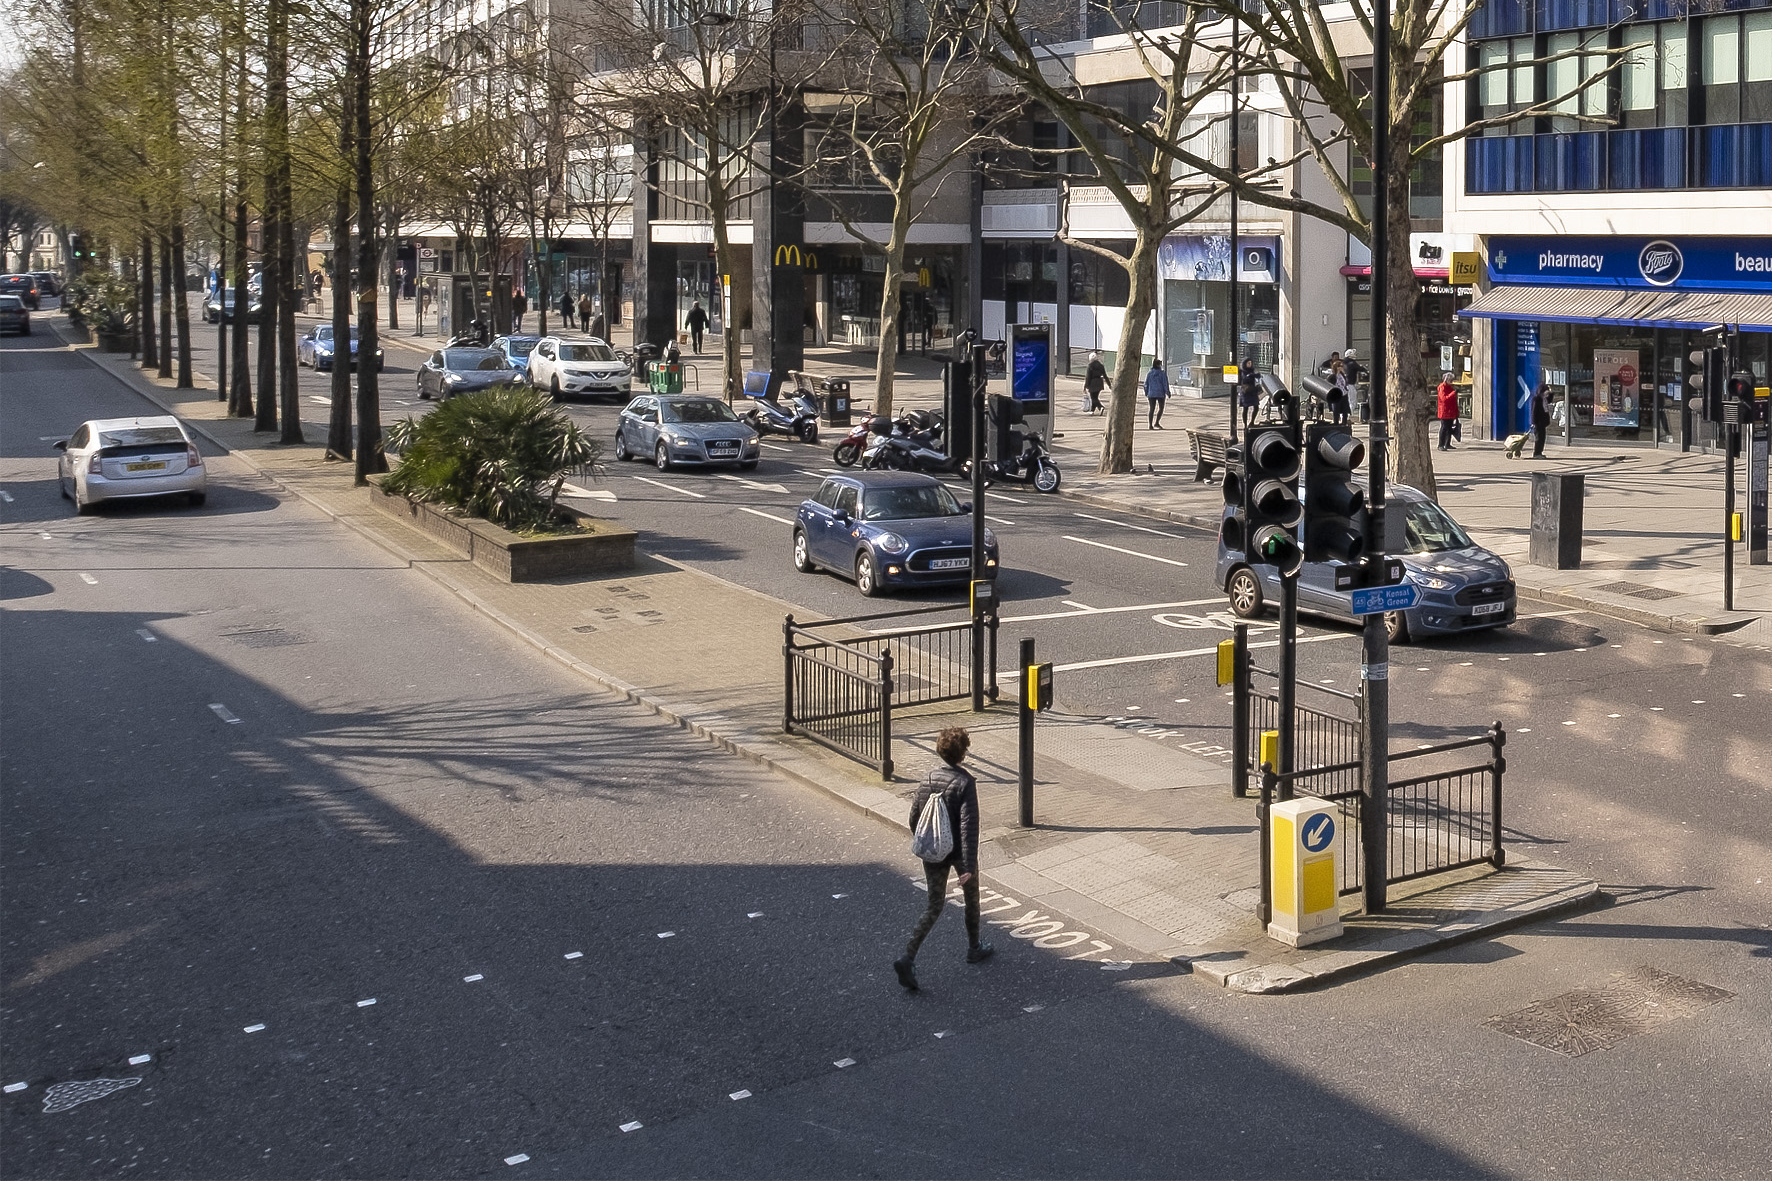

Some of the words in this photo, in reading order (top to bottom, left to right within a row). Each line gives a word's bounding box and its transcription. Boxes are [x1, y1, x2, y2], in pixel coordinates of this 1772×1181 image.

[1456, 261, 1477, 274] itsu
[1539, 250, 1604, 272] pharmacy
[1643, 249, 1674, 275] Boots
[1385, 588, 1410, 598] Kensal
[1386, 598, 1409, 607] Green
[1114, 719, 1185, 739] LOOK
[986, 909, 1113, 961] LOOK
